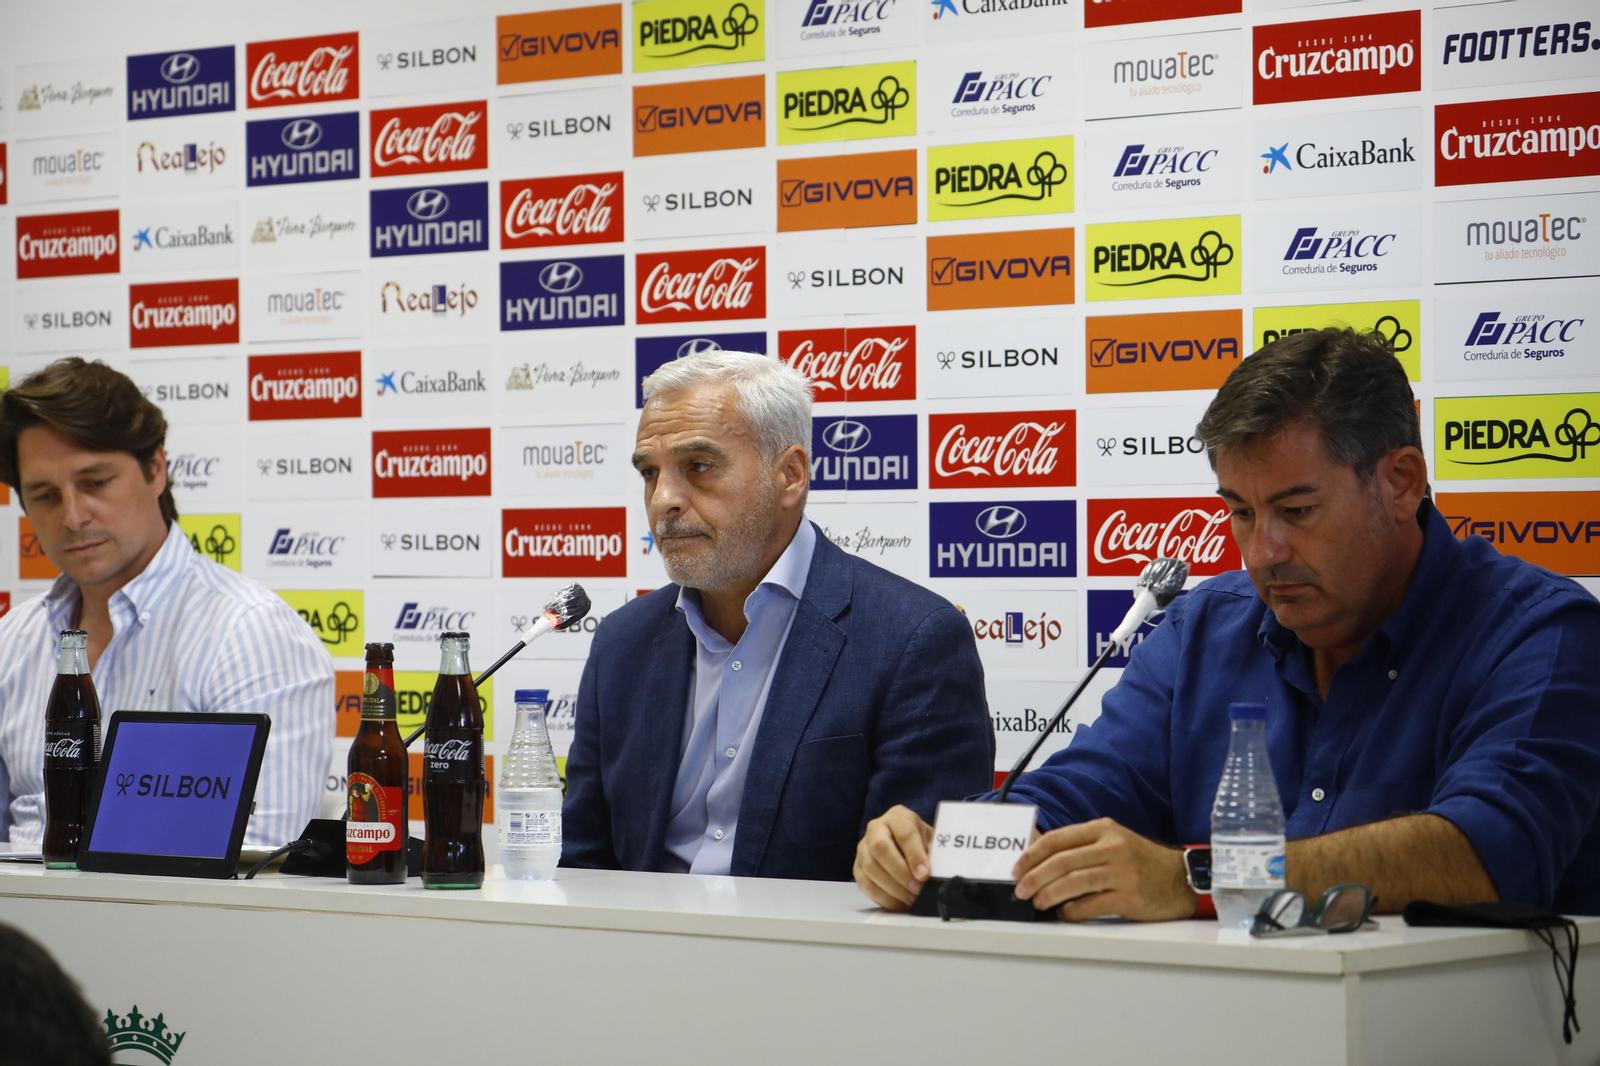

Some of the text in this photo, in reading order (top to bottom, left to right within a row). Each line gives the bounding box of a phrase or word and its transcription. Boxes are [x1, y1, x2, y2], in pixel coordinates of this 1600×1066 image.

[831, 0, 897, 24] PACC
[521, 29, 619, 57] GIVOVA
[848, 24, 881, 39] Seguros
[1297, 33, 1373, 48] DESDE 1904
[397, 45, 477, 69] SILBON
[1258, 42, 1414, 80] Cruzcampo
[250, 45, 355, 102] Coca-Cola
[132, 82, 230, 113] HYUNDAI
[984, 75, 1053, 102] PACC
[1138, 84, 1161, 96] aliado
[658, 101, 762, 129] GIVOVA
[990, 105, 1000, 114] de
[1001, 102, 1036, 116] Seguros
[1482, 115, 1562, 128] DESDE 1904
[374, 110, 483, 168] Coca-Cola
[528, 115, 611, 138] SILBON
[1296, 137, 1416, 169] CaixaBank
[1440, 124, 1600, 161] Cruzcampo
[252, 149, 354, 180] HYUNDAI
[1146, 149, 1219, 176] PACC
[803, 175, 913, 204] GIVOVA
[1153, 178, 1164, 189] de
[1165, 176, 1201, 190] Seguros
[505, 183, 619, 240] Coca-Cola
[665, 188, 752, 211] SILBON
[19, 231, 117, 260] Cruzcampo
[155, 223, 235, 250] CaixaBank
[375, 219, 482, 250] HYUNDAI
[1318, 232, 1397, 259] PACC
[1331, 229, 1360, 238] GRUPO
[1485, 245, 1567, 262] tu aliado tecnológico
[811, 266, 904, 288] SILBON
[955, 255, 1071, 282] GIVOVA
[1326, 262, 1338, 274] de
[1339, 261, 1378, 275] Seguros
[641, 257, 760, 314] Coca-Cola
[42, 310, 111, 329] SILBON
[132, 301, 236, 331] Cruzcampo
[506, 293, 617, 322] HYUNDAI
[1515, 314, 1545, 322] GRUPO
[1502, 318, 1585, 345] PACC
[961, 347, 1058, 369] SILBON
[1115, 338, 1238, 364] GIVOVA
[1510, 348, 1522, 359] de
[1523, 347, 1565, 361] Seguros
[156, 382, 229, 401] SILBON
[251, 372, 358, 404] Cruzcampo
[401, 370, 487, 395] CaixaBank
[934, 421, 1067, 478] Coca-Cola
[1123, 436, 1206, 456] SILBO
[277, 457, 352, 475] SILBON
[374, 449, 488, 481] Cruzcampo
[810, 455, 909, 481] YUNDAI
[293, 535, 345, 556] PACC
[400, 534, 480, 551] SILBON
[505, 527, 622, 562] Cruzcampo
[1094, 508, 1232, 564] Coca-Cola
[937, 542, 1067, 568] HYUNDAI
[419, 611, 476, 631] PACC
[430, 761, 450, 769] zero
[137, 774, 232, 800] SILBON
[953, 834, 1028, 852] SILBON
